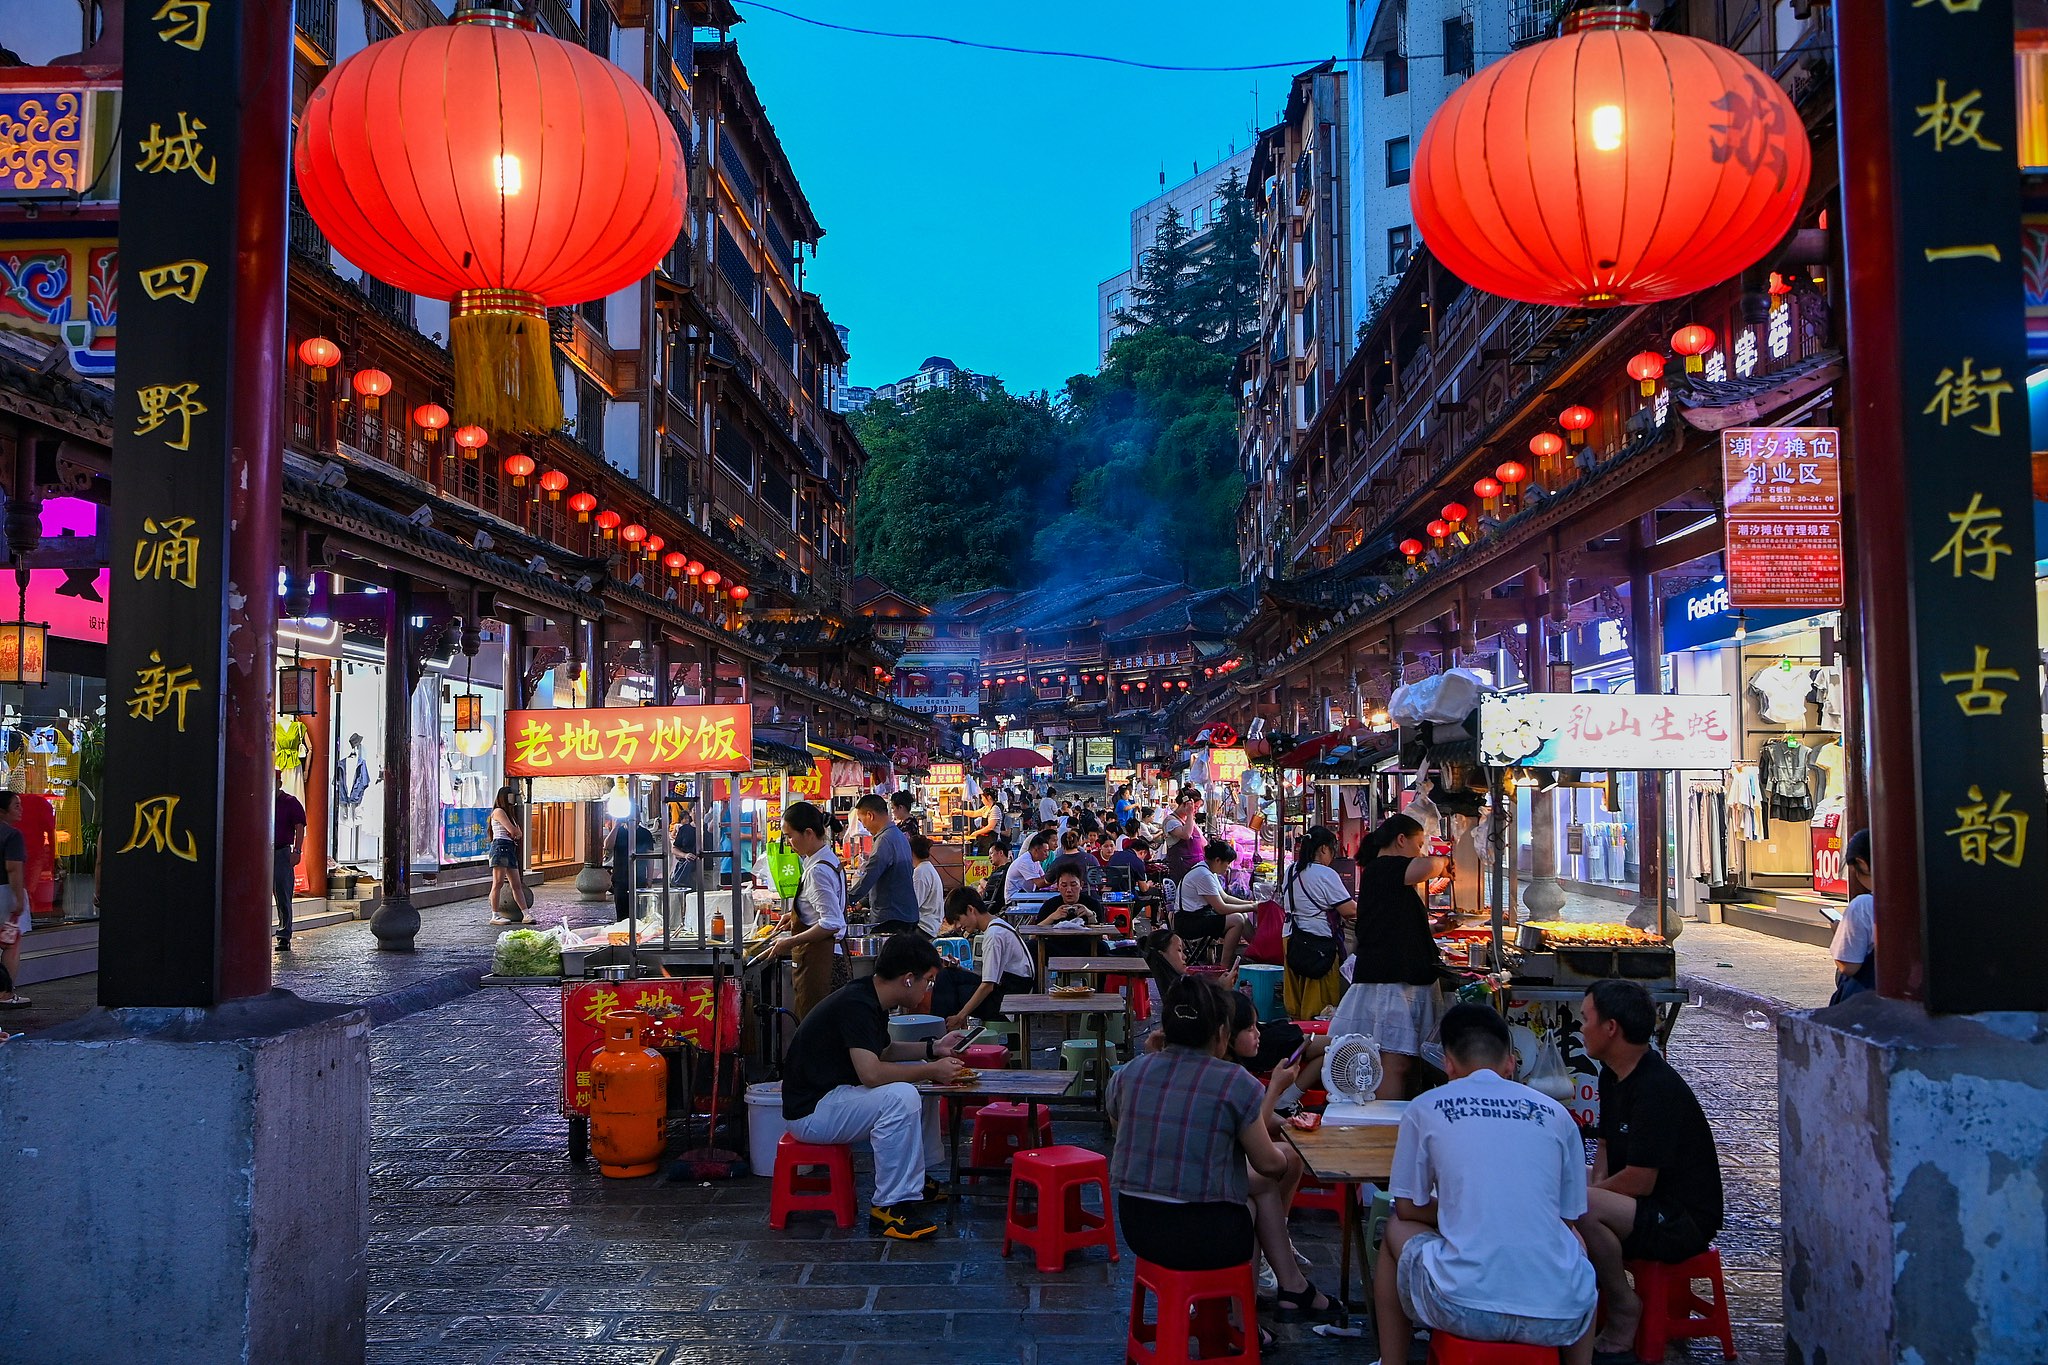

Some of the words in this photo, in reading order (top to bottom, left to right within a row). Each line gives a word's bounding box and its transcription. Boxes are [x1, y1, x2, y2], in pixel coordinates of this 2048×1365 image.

[1729, 437, 1835, 459] 潮汐摊位
[1911, 0, 2029, 868] 板一街存古韵
[1743, 462, 1823, 485] 创业区
[1737, 524, 1831, 536] 潮汐摊位管理规定
[513, 715, 744, 767] 老地方炒饭
[1566, 704, 1729, 742] 乳山生蚝
[583, 987, 715, 1025] 老地方
